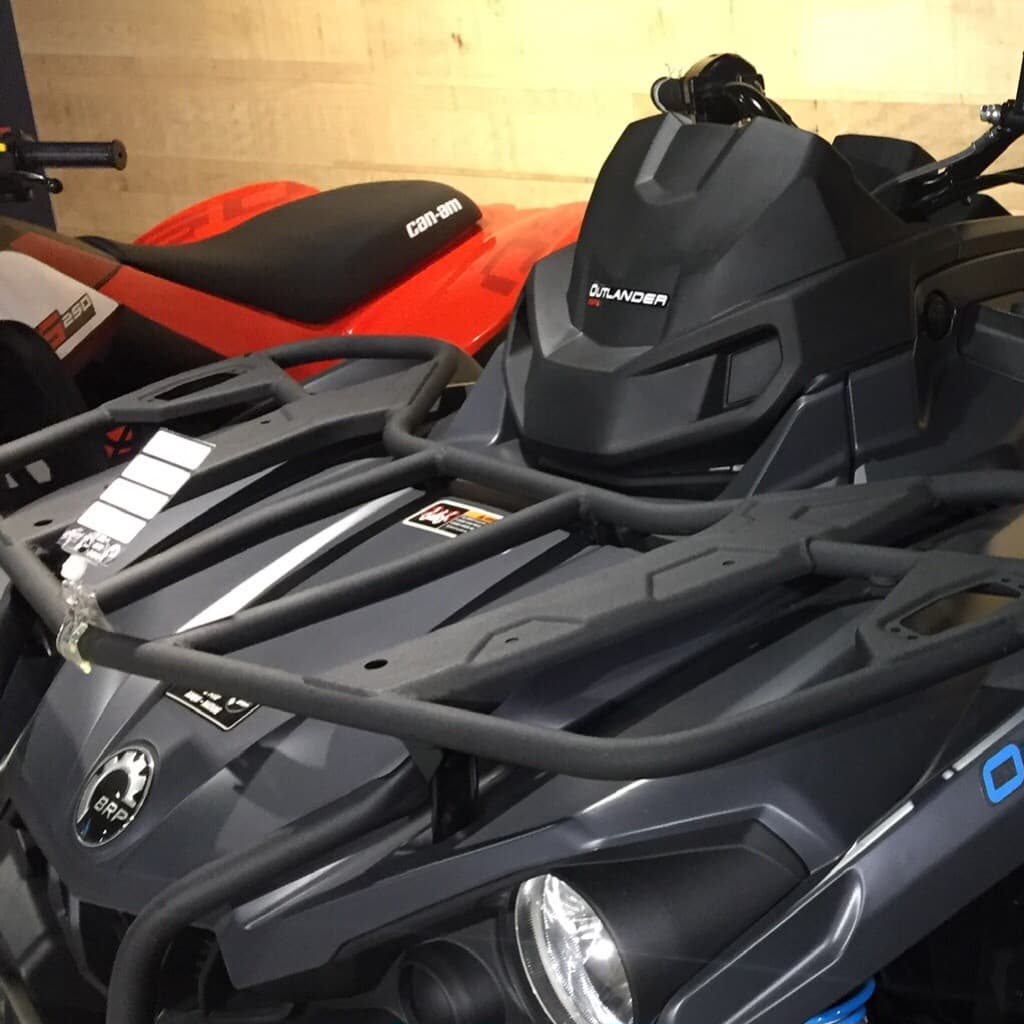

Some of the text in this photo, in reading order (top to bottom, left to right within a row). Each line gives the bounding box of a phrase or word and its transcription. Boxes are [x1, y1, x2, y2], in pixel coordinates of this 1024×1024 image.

[405, 198, 463, 239] can-am
[588, 282, 668, 306] OUTLANDER
[93, 795, 129, 823] BRP
